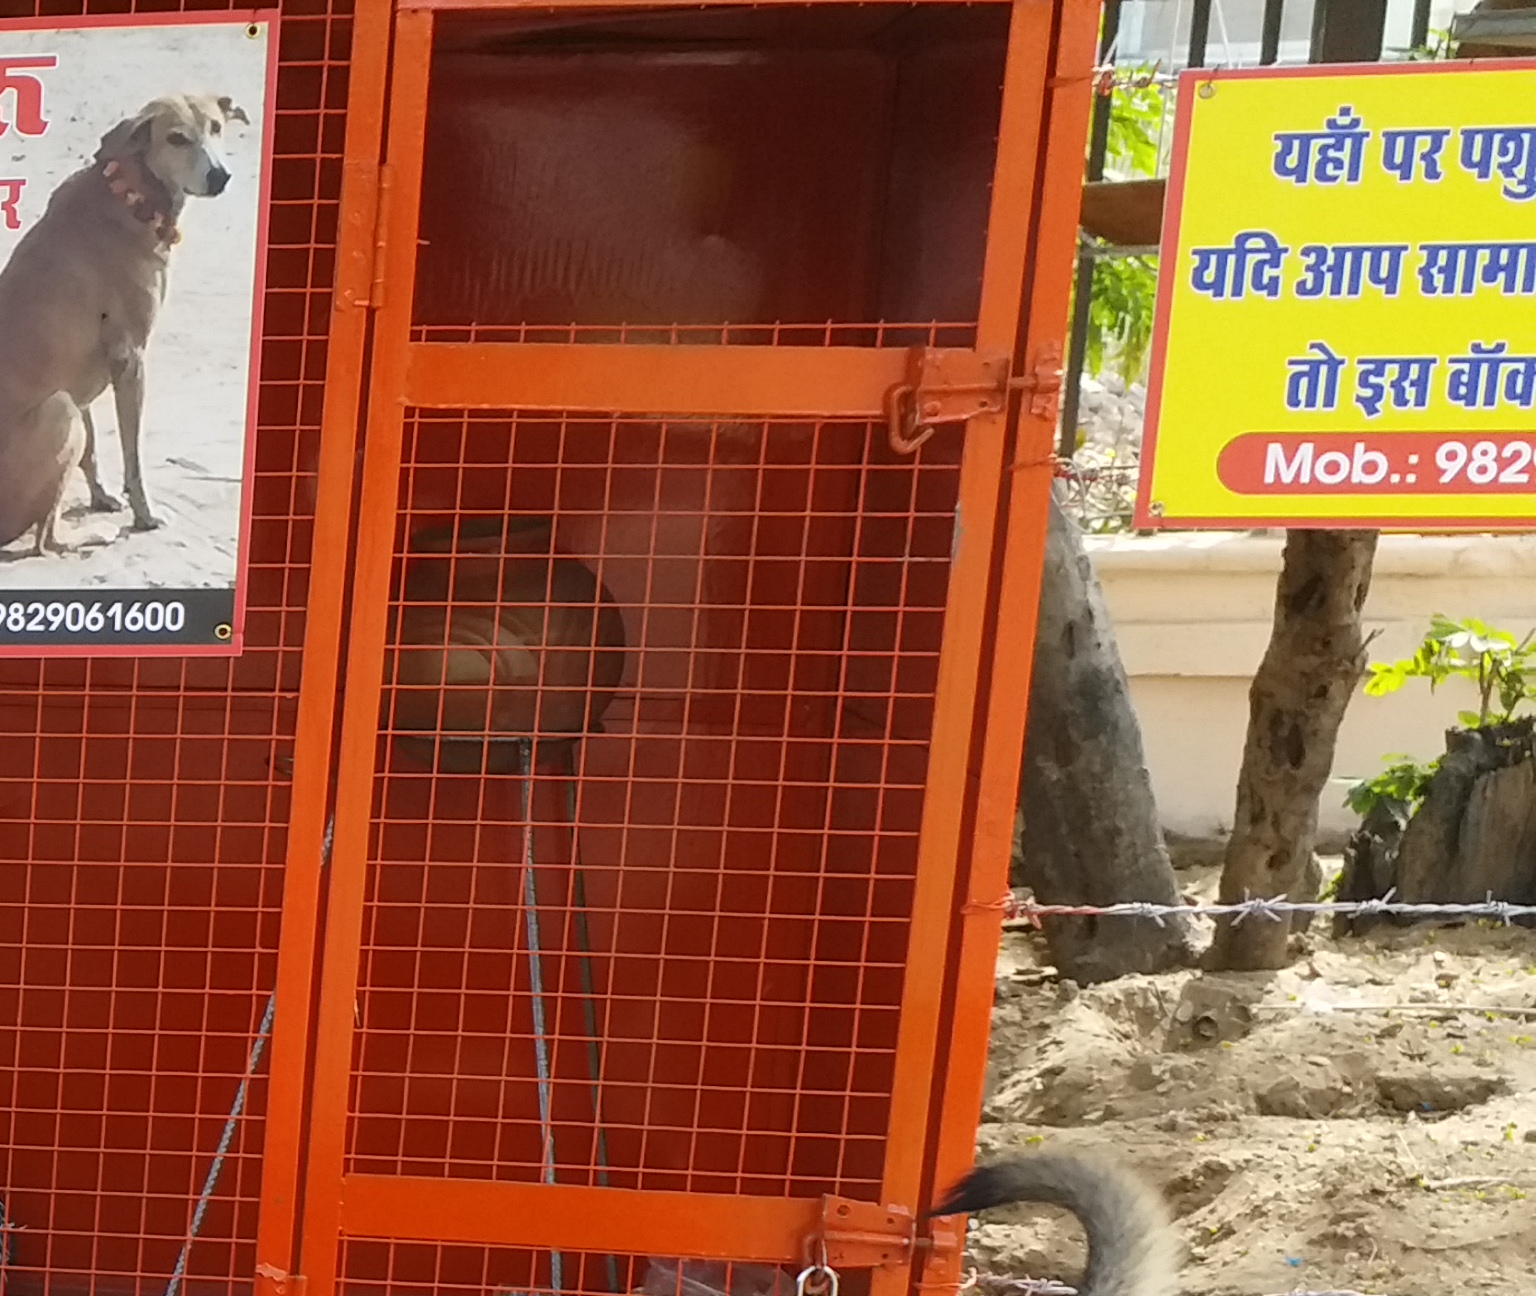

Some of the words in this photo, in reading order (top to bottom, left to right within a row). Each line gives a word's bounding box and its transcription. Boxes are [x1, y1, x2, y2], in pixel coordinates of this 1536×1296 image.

[1273, 105, 1371, 184] यहाँ
[1381, 128, 1451, 181] पर
[1191, 230, 1290, 298] यदि
[1295, 243, 1409, 297] आप
[1285, 341, 1346, 409] तो
[1354, 356, 1437, 417] इस
[1263, 441, 1419, 484] Mob.:
[1434, 440, 1536, 485] 982
